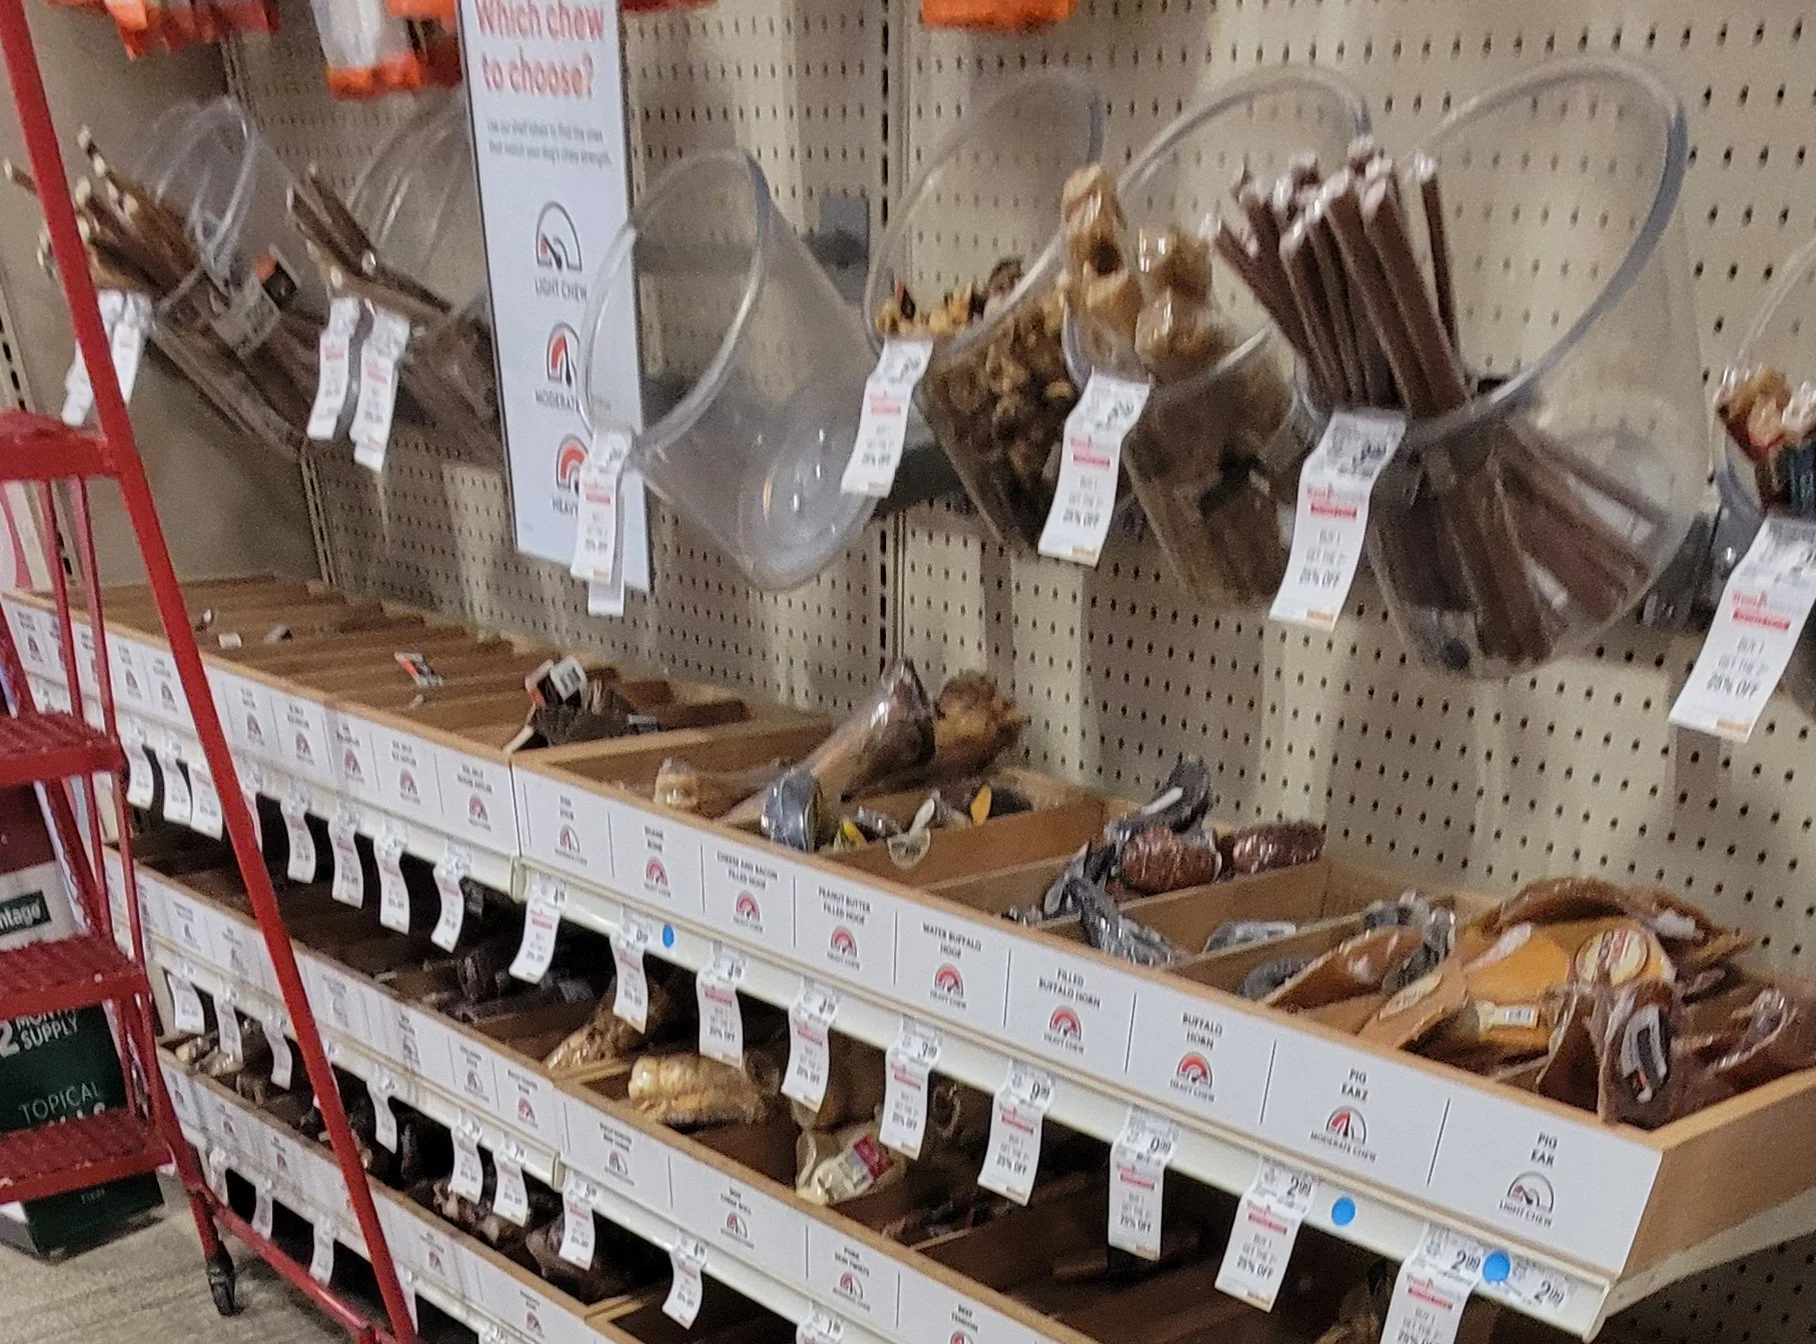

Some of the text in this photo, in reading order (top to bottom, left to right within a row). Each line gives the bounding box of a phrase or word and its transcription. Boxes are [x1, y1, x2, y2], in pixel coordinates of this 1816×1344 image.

[475, 0, 604, 42] Which chew
[482, 46, 594, 99] to choose?
[535, 390, 580, 413] MODERAT
[818, 885, 871, 913] PEANUT BUTTER
[845, 908, 866, 926] HOOF
[922, 921, 982, 953] WATER BUFFALO
[939, 942, 962, 960] HOOF
[1056, 967, 1085, 988] FILLED
[1038, 977, 1101, 1009] BUFFALO HORN
[20, 1014, 78, 1051] SUPPLY
[1181, 1011, 1224, 1036] BUFFALO
[1186, 1031, 1215, 1051] HORN
[1349, 1068, 1368, 1085] PIG
[18, 1080, 101, 1125] TOPICAL
[1537, 1132, 1559, 1150] PIG
[1530, 1148, 1555, 1168] EAR
